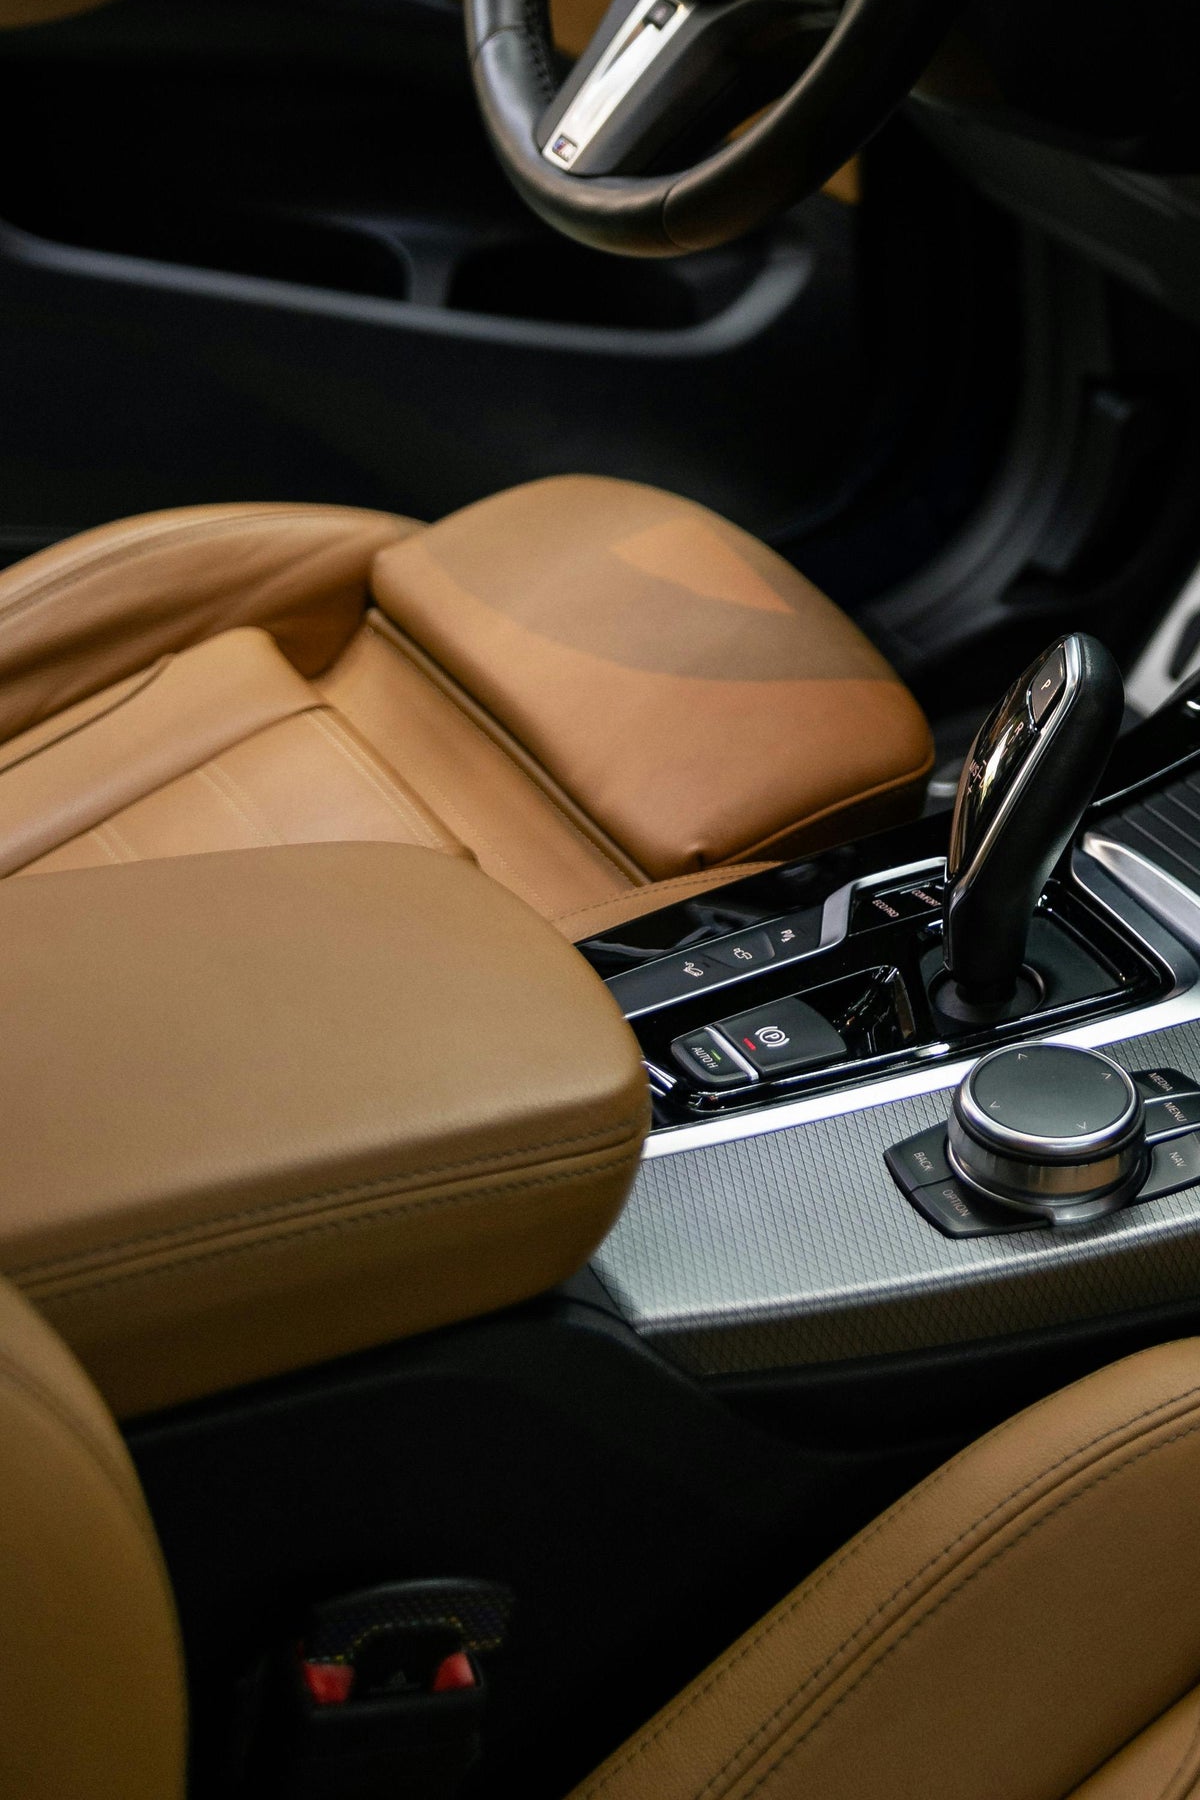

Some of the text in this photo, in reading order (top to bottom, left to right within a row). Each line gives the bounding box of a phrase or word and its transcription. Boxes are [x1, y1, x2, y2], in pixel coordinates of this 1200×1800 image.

[1040, 678, 1052, 690] P
[1014, 721, 1025, 736] R
[691, 1046, 719, 1070] AUTO H
[1147, 1072, 1174, 1092] MEDIA
[1163, 1101, 1188, 1122] MENU
[913, 1151, 935, 1172] BACK
[1168, 1151, 1188, 1168] NAV
[942, 1189, 972, 1217] OPTION
